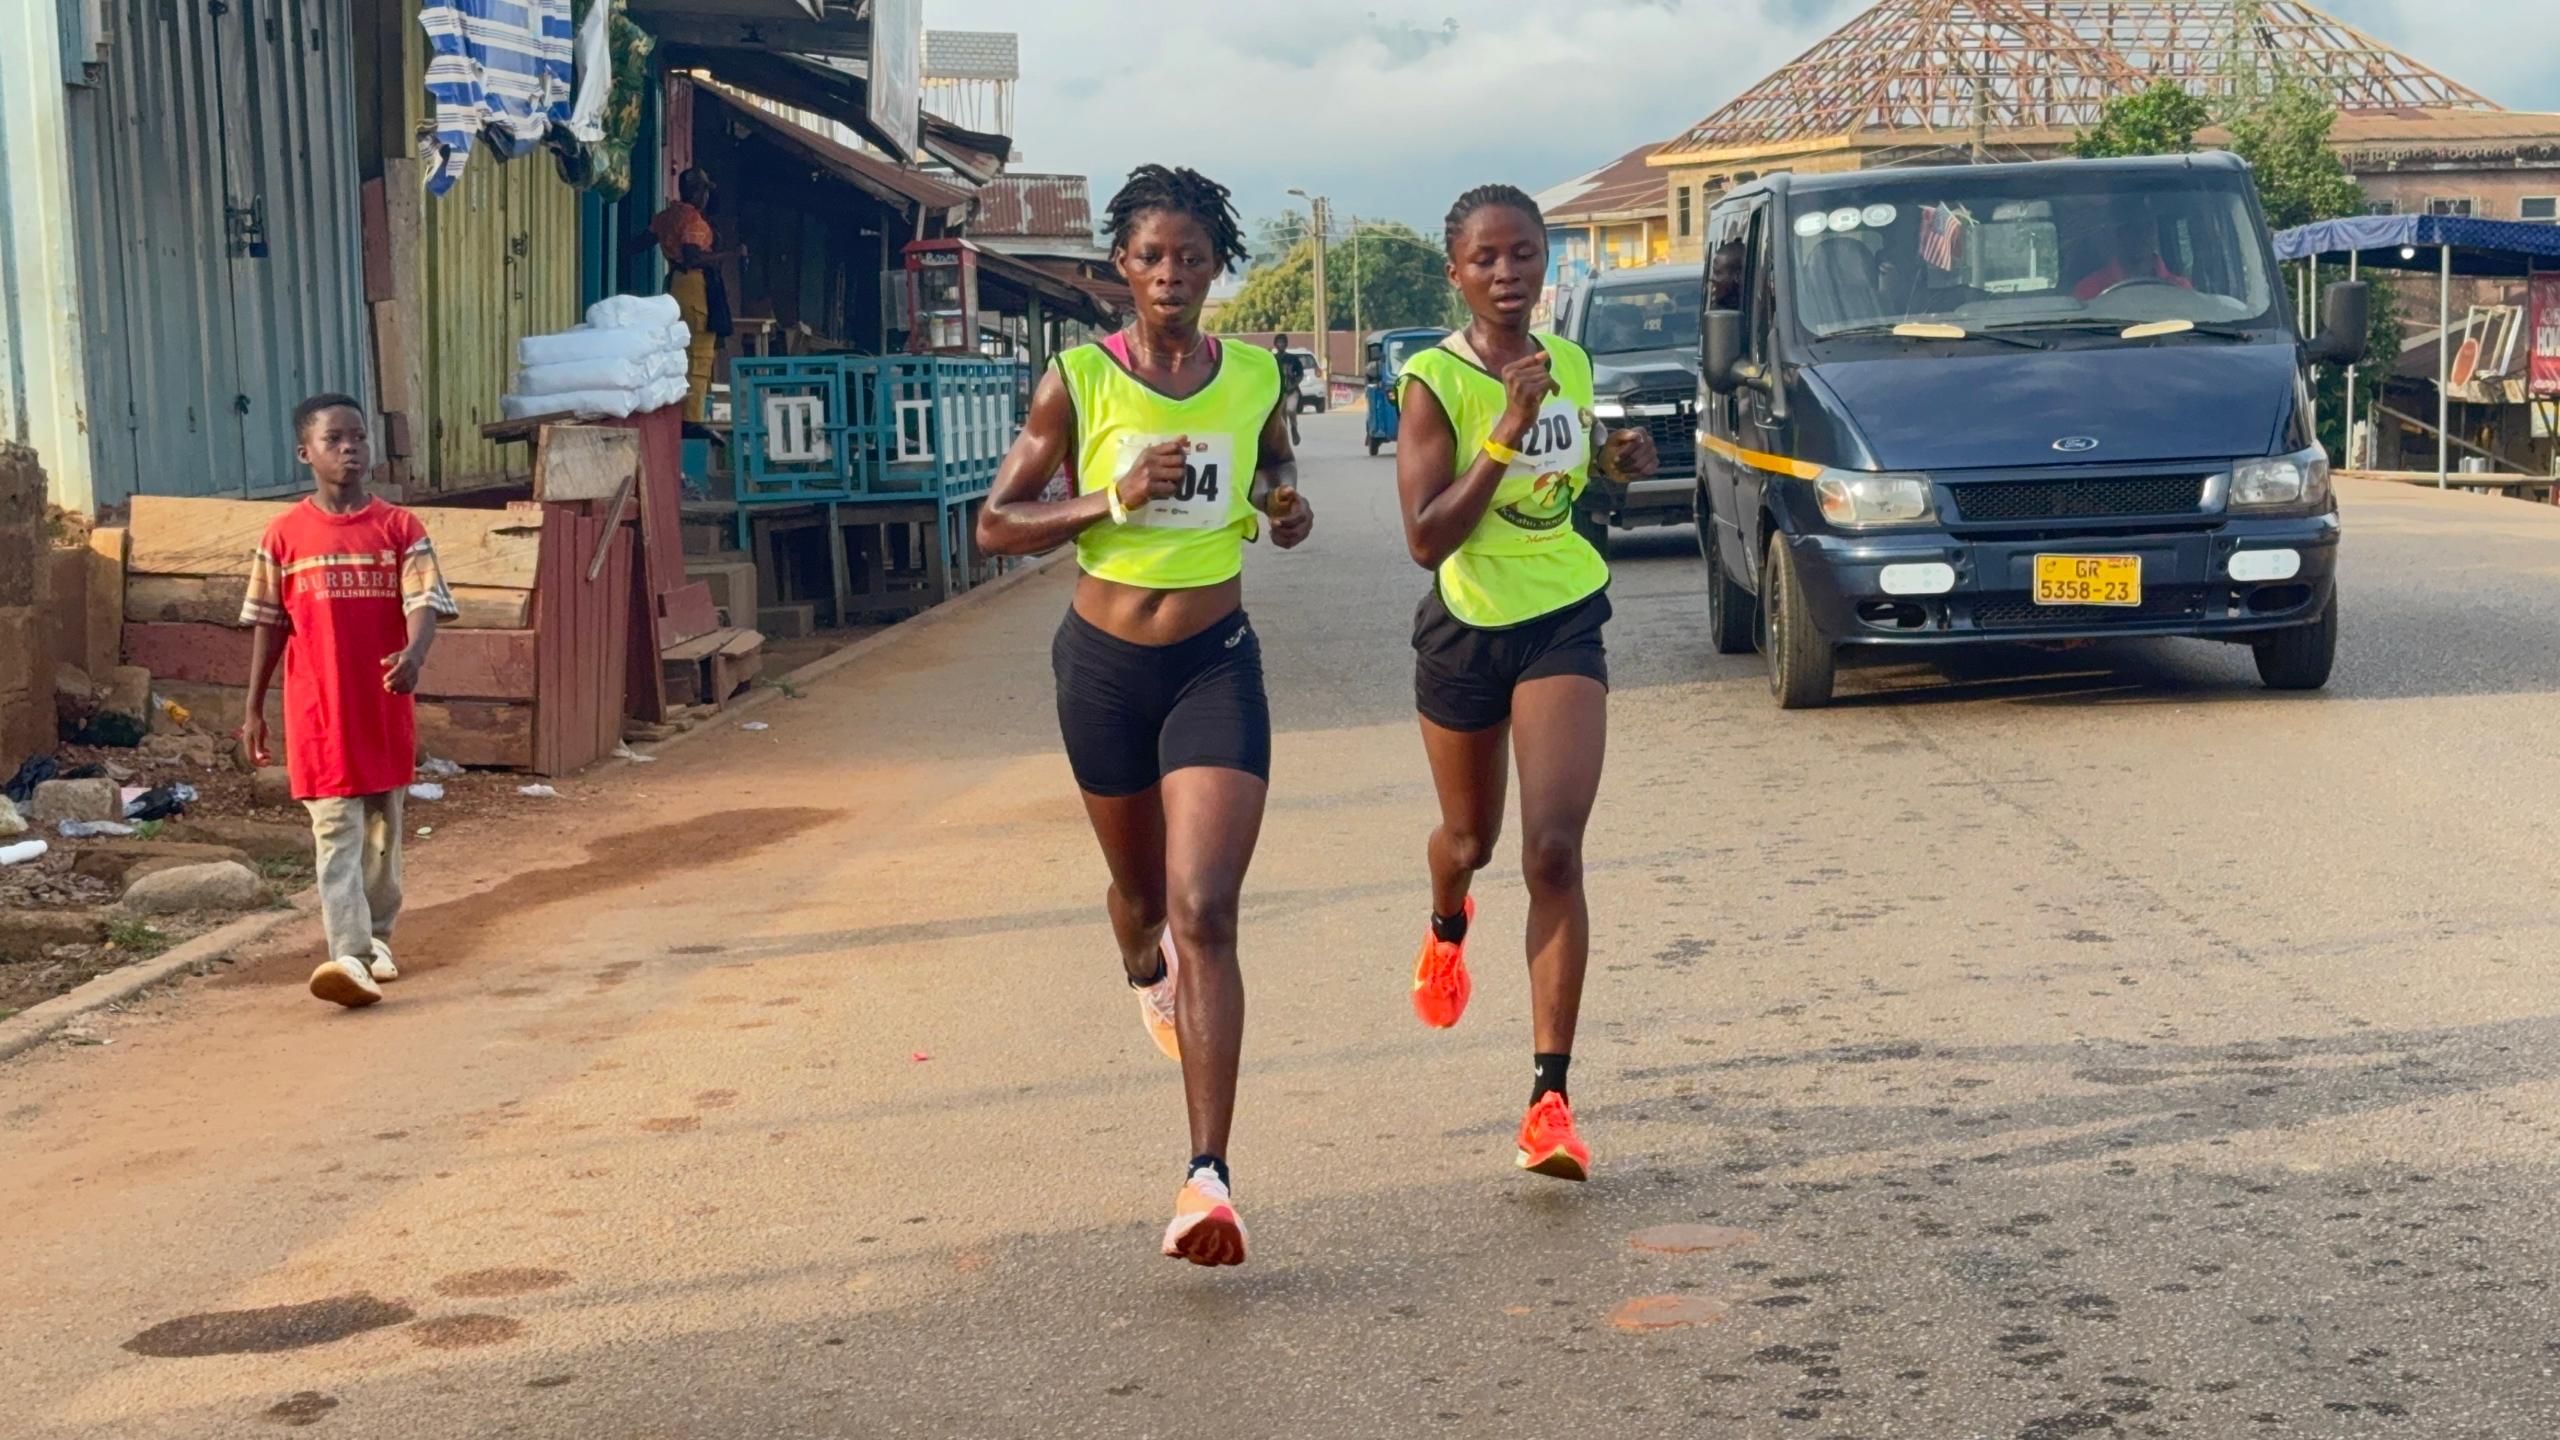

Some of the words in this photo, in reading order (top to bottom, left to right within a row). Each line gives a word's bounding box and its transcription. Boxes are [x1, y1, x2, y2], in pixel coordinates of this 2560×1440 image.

[1520, 414, 1572, 456] 270
[1160, 464, 1219, 502] 04
[2075, 560, 2100, 578] GR
[2041, 580, 2129, 601] 5358-23
